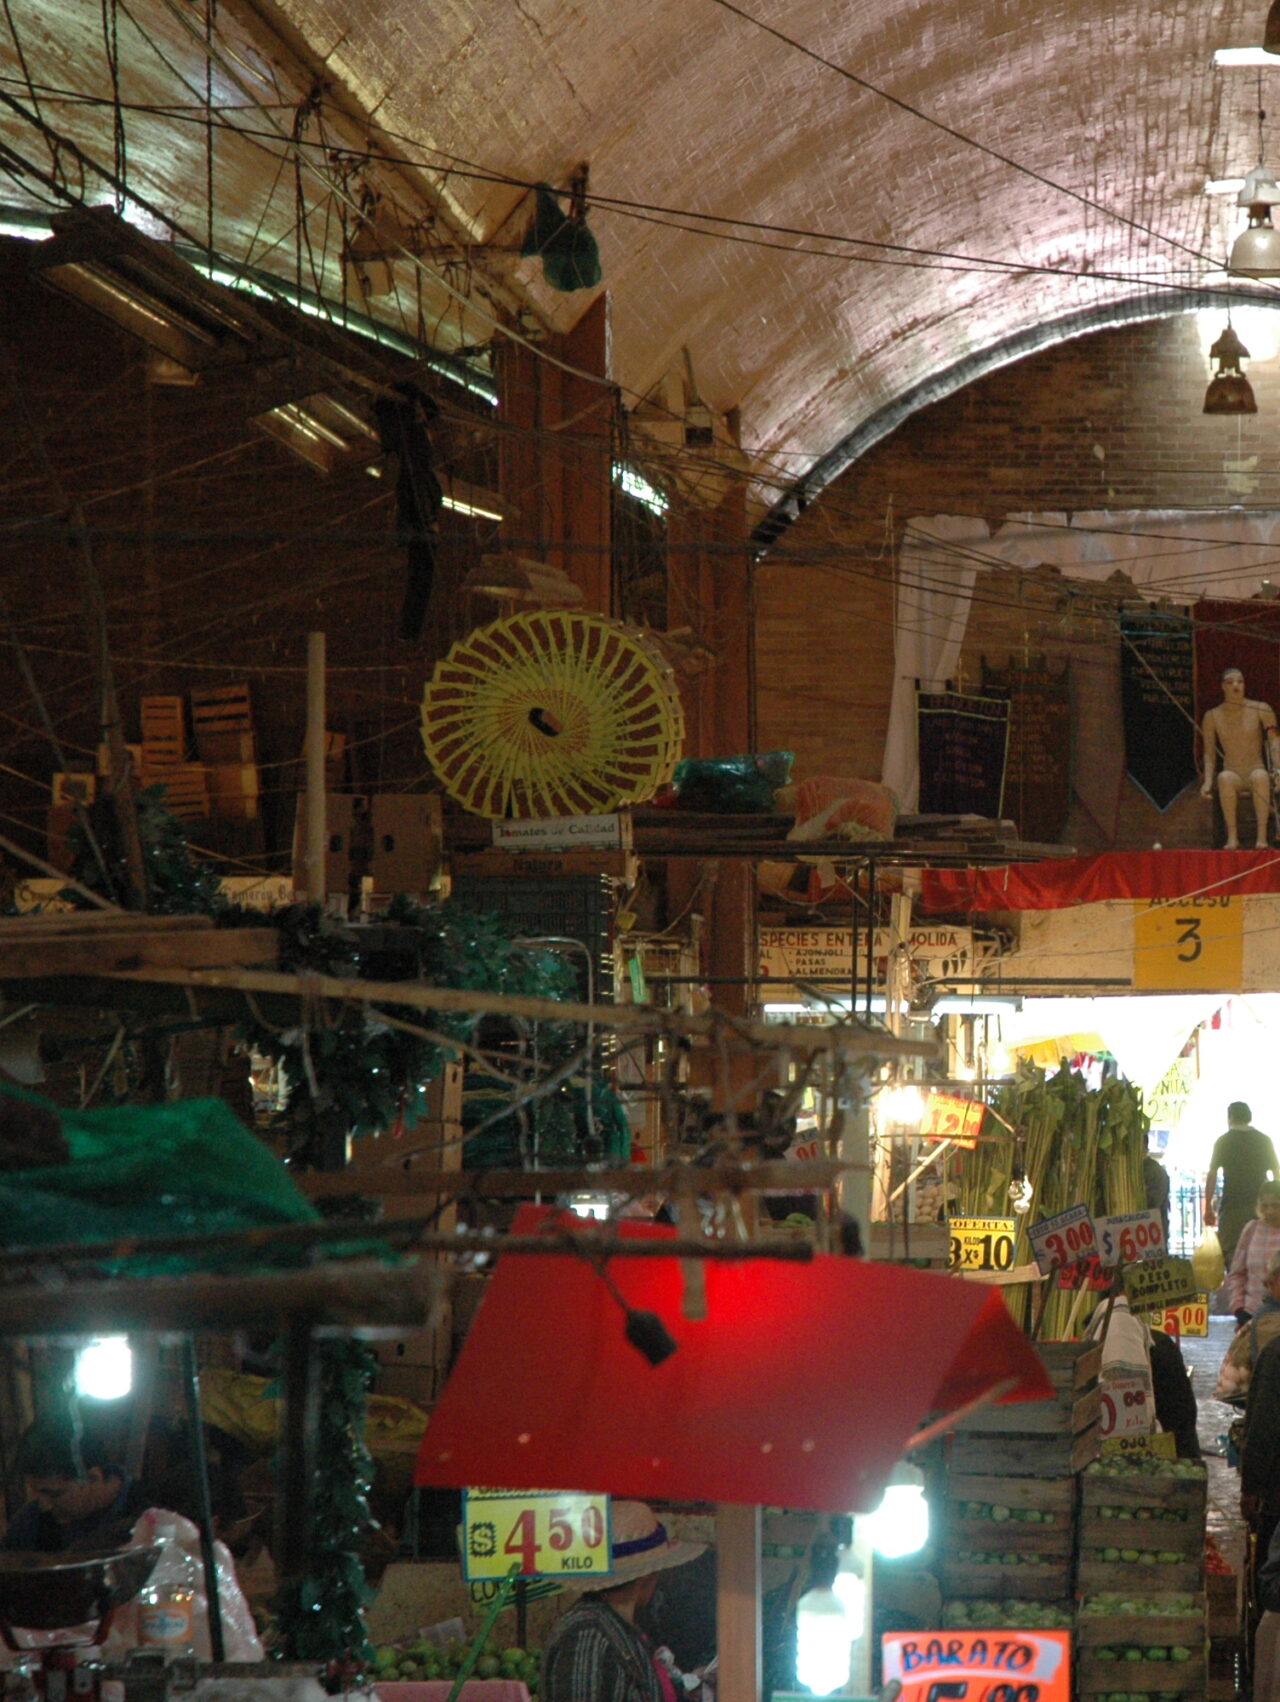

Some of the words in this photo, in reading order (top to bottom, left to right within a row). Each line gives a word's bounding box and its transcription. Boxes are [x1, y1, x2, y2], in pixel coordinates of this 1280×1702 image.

[496, 825, 547, 838] Tomates
[569, 823, 615, 835] Calidad
[760, 932, 819, 946] SPECIES
[1175, 918, 1202, 962] 3
[796, 958, 827, 966] PASAS
[954, 1220, 1008, 1230] OFERTA
[979, 1234, 1014, 1271] 10
[1132, 1278, 1188, 1299] COMPLETO
[1120, 1436, 1147, 1450] OJO
[561, 1556, 593, 1570] KILO
[902, 1639, 1034, 1671] BARATO
